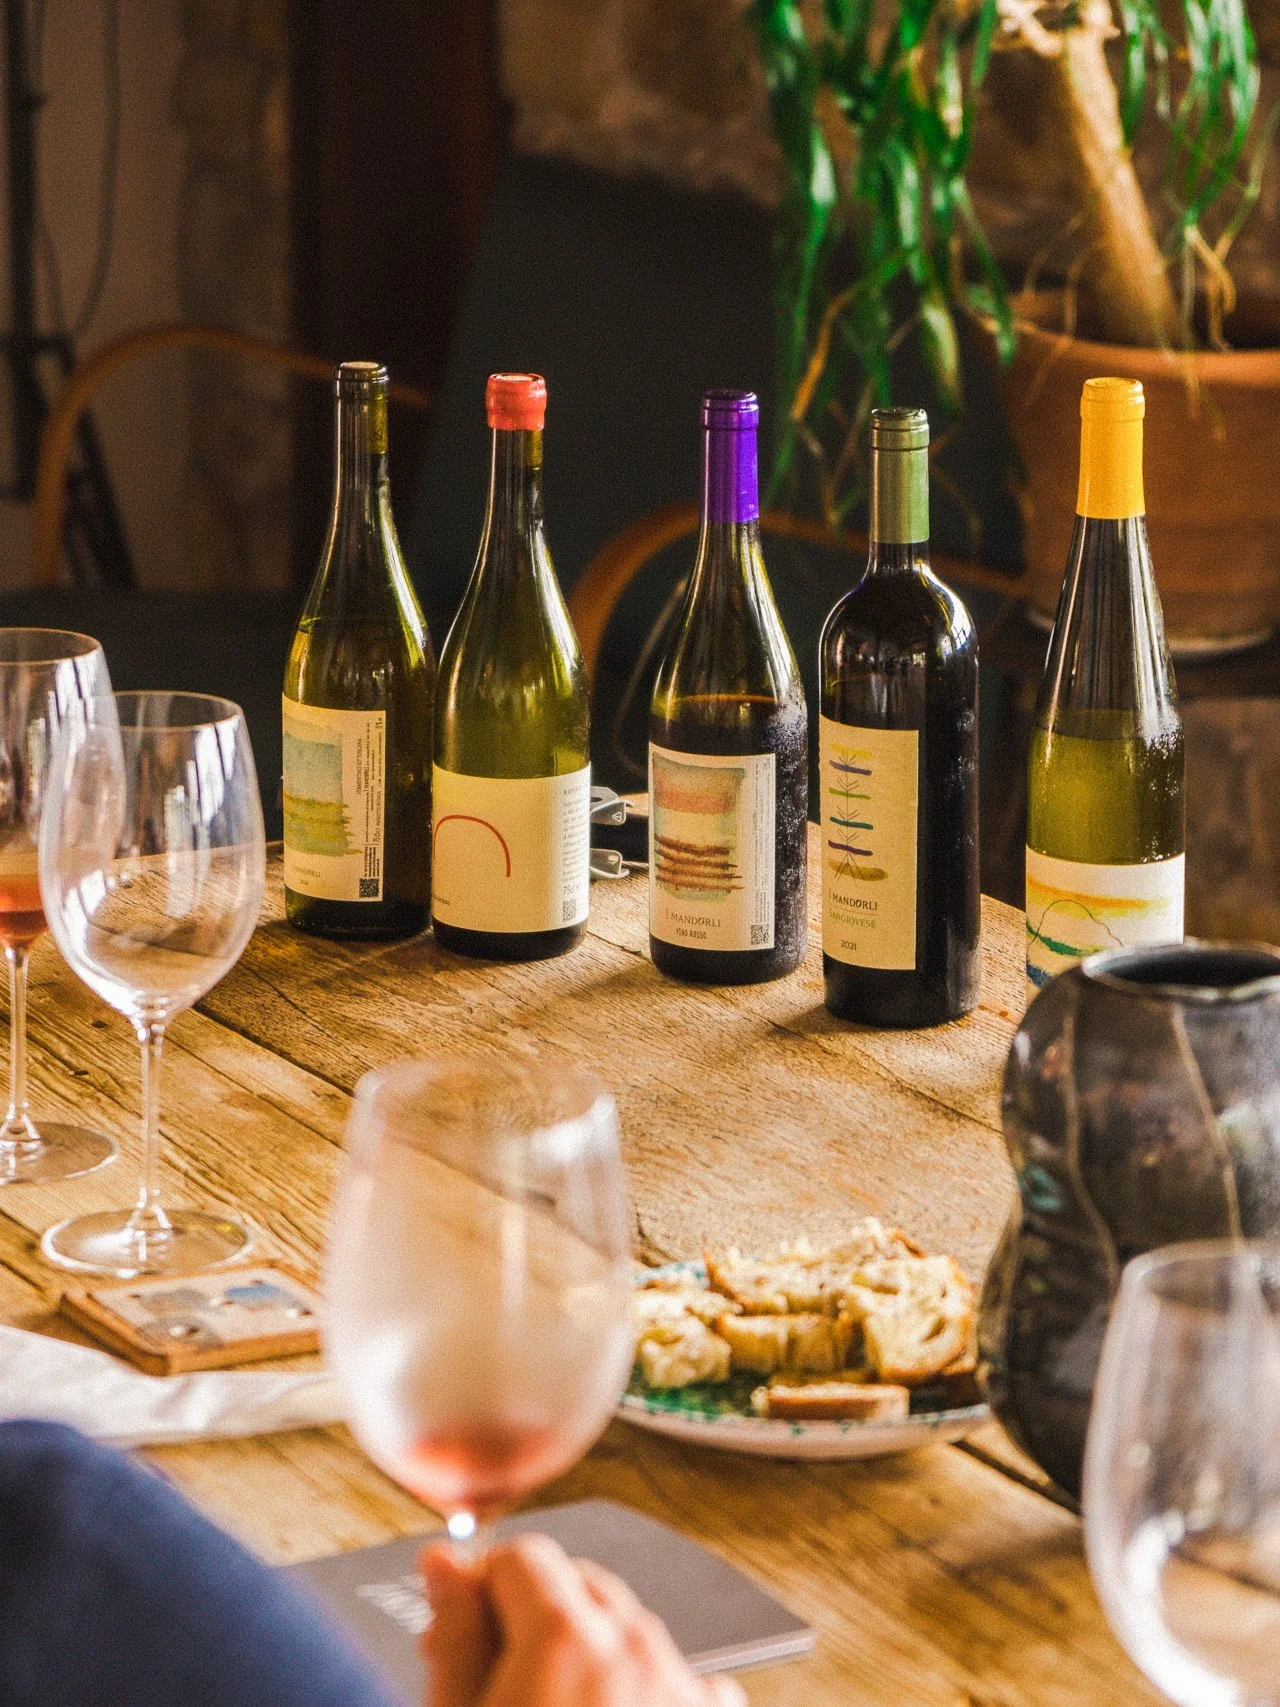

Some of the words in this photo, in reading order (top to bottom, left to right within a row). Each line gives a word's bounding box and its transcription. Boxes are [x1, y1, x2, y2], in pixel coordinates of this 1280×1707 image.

[832, 892, 878, 911] MANDORLI
[671, 912, 721, 928] MANDORLI
[829, 908, 877, 929] SANGIOVESE
[676, 927, 688, 937] VINO
[690, 929, 707, 940] ROSSO
[840, 939, 857, 951] 2021
